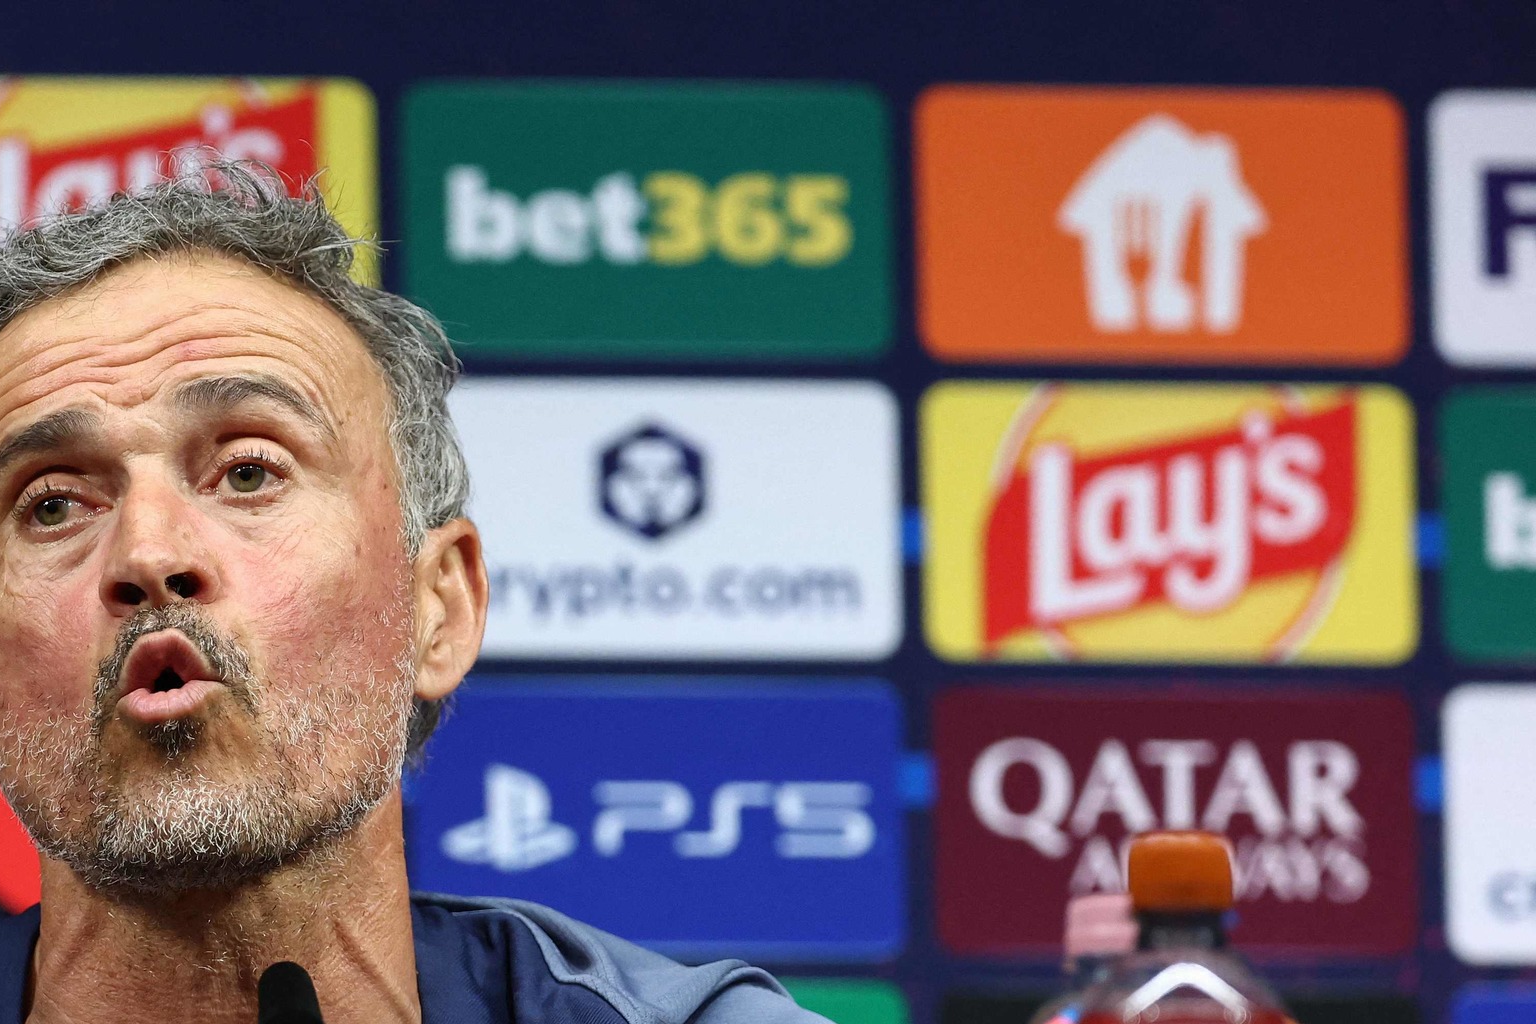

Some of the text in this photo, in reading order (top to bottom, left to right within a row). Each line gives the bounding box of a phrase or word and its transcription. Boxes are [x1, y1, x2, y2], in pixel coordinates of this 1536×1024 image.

[444, 163, 854, 267] bet365
[1026, 408, 1330, 624] Lay's
[488, 560, 864, 626] rypto.com
[591, 779, 876, 859] PS5
[968, 736, 1366, 860] QATAR
